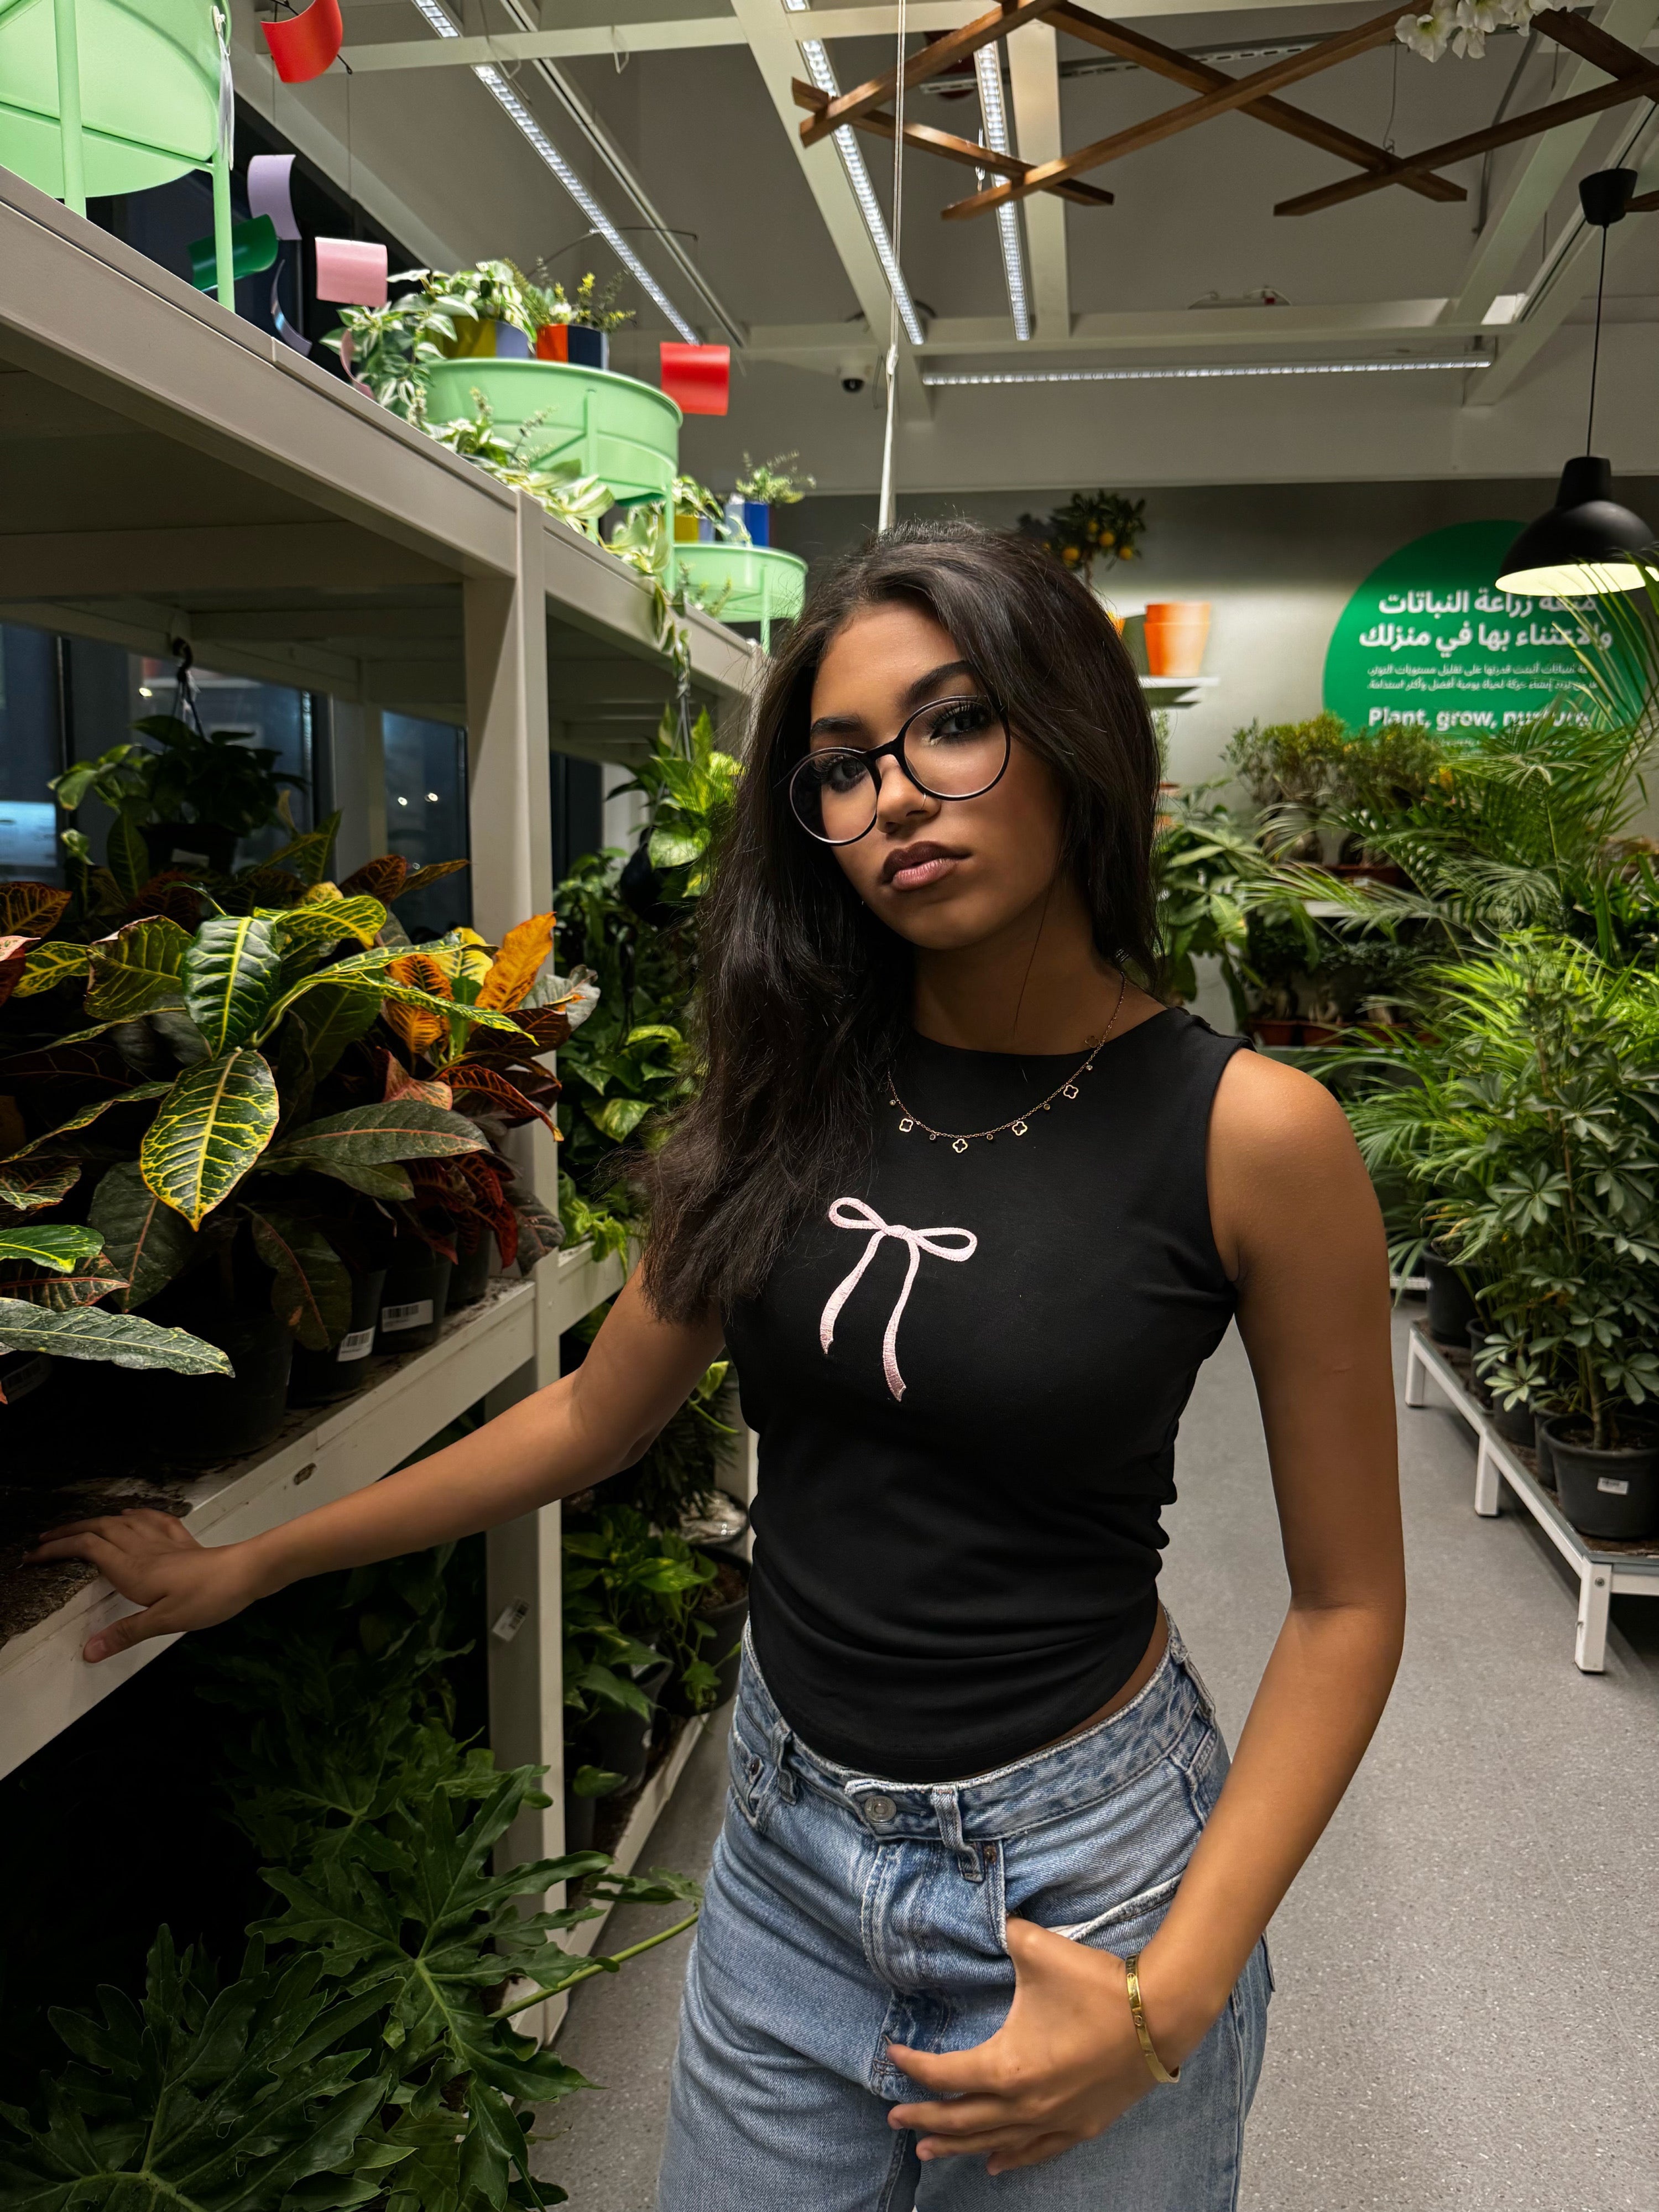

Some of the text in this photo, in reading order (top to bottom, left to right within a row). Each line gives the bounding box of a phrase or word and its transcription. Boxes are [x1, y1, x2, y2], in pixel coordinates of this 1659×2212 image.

[1379, 589, 1470, 619] النباتات
[1474, 587, 1533, 618] زراعة
[1359, 622, 1432, 653] منزلك
[1435, 619, 1474, 659] في
[1478, 622, 1511, 652] بها
[1464, 663, 1483, 676] على
[1369, 706, 1432, 728] Plant,
[1436, 710, 1498, 731] grow,
